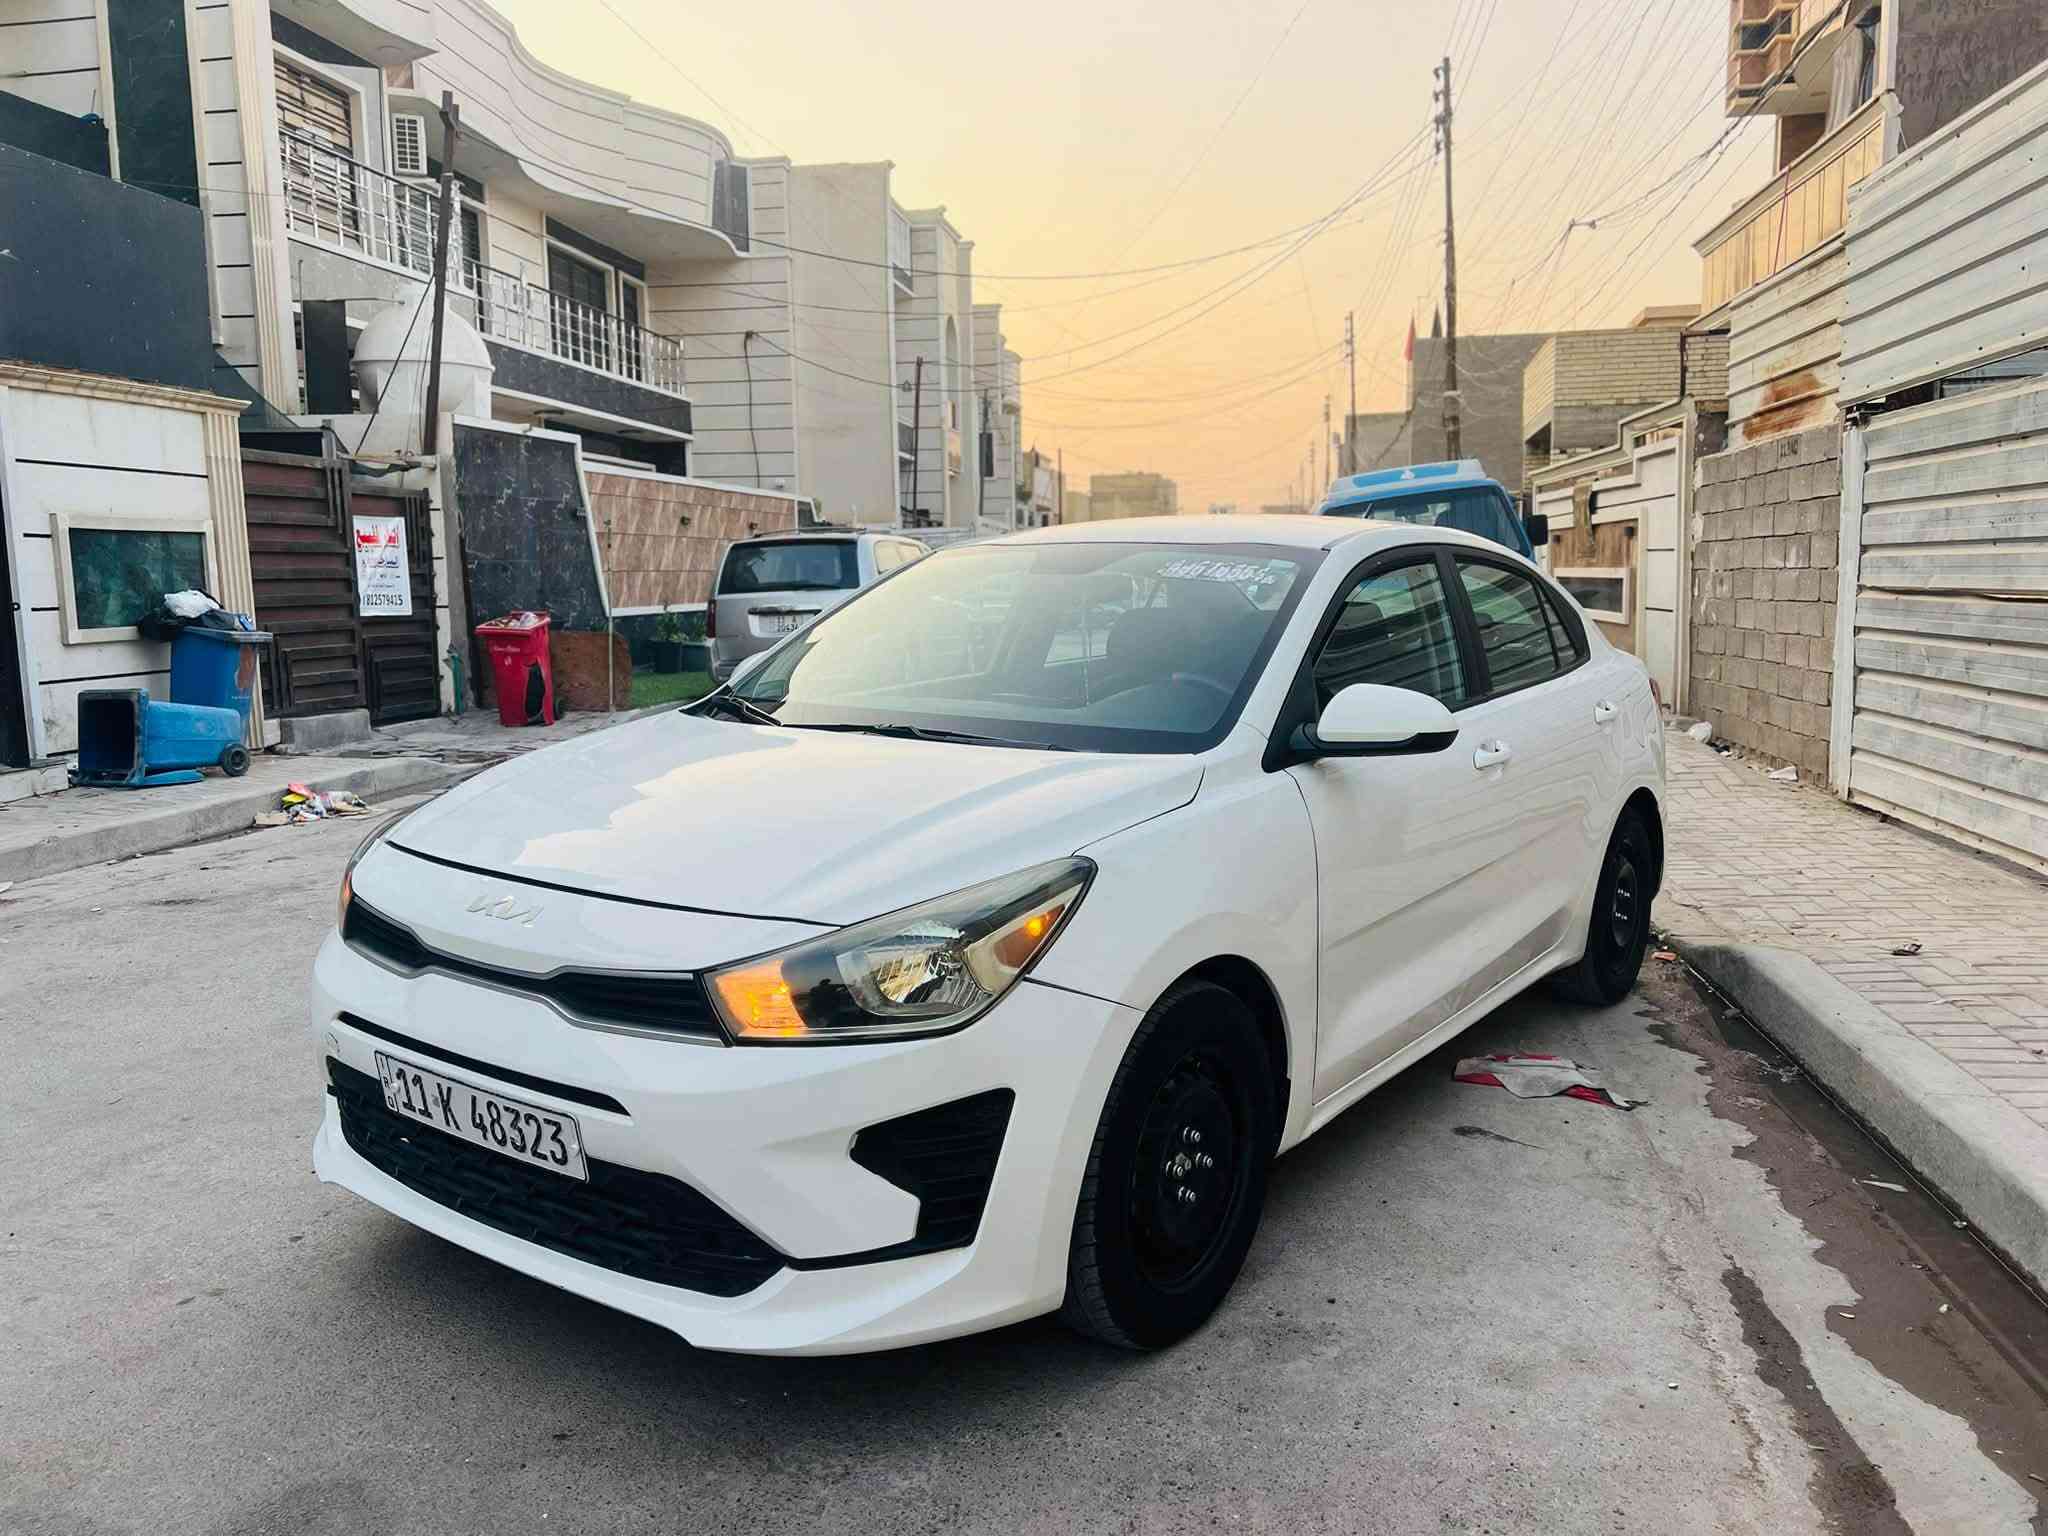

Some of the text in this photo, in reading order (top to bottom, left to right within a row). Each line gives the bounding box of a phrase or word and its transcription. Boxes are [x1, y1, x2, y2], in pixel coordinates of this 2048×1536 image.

[396, 1068, 569, 1166] 11 K 48323
